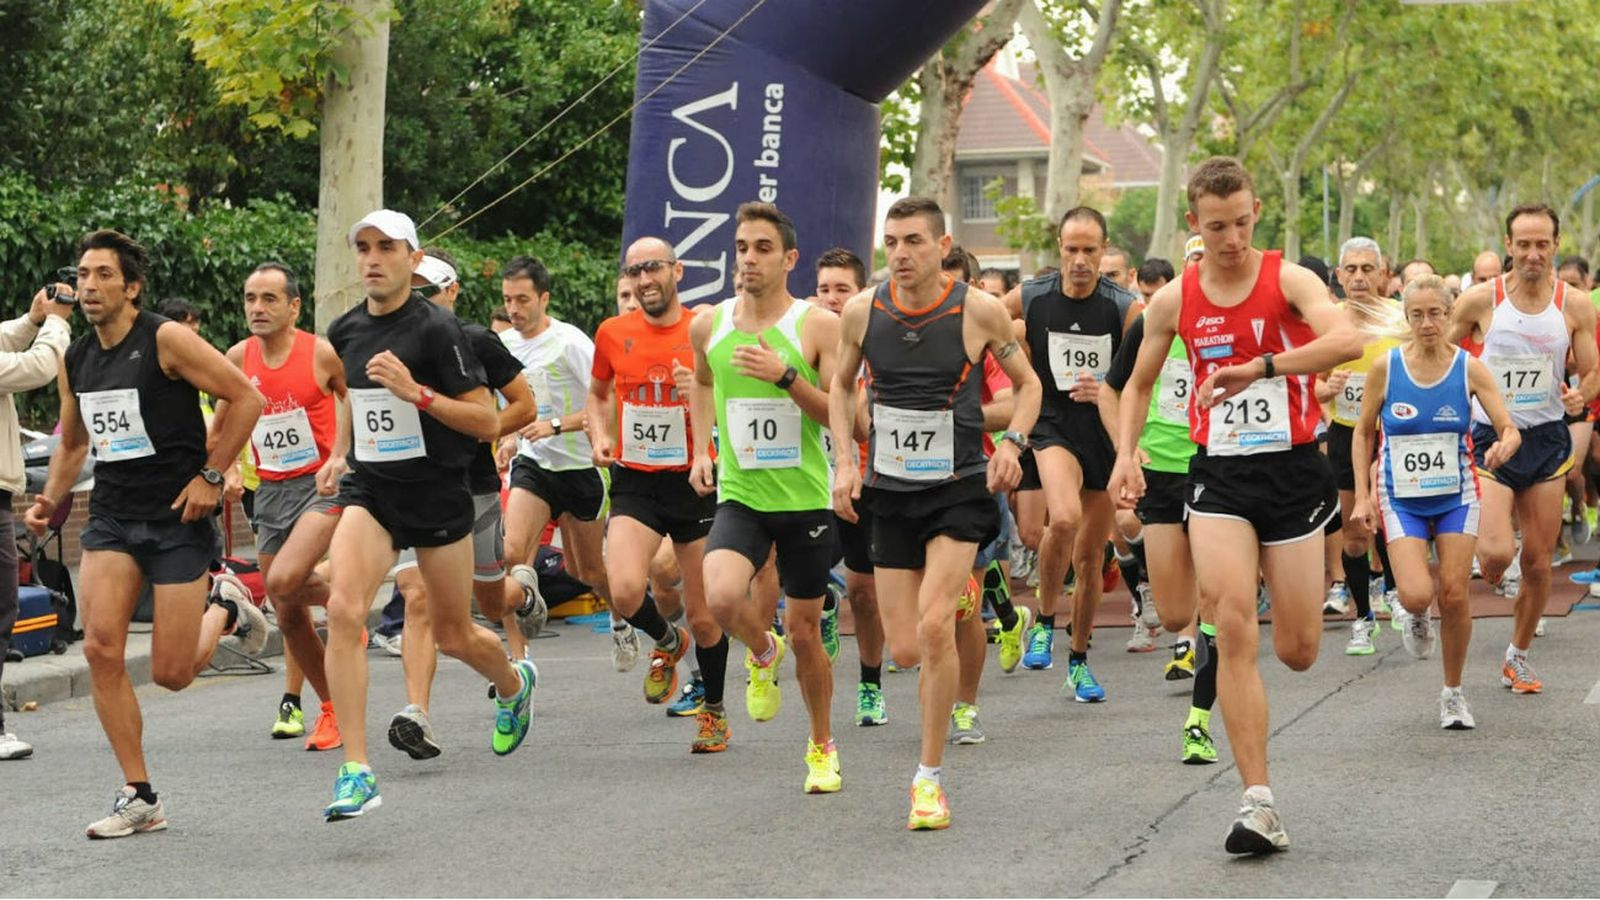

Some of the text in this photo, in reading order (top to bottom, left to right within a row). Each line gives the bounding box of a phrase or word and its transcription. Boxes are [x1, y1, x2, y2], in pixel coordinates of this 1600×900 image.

[754, 83, 784, 167] banca
[1194, 333, 1234, 347] MARATHON
[1063, 348, 1099, 368] 198
[1502, 370, 1541, 388] 177
[92, 409, 130, 434] 554
[366, 409, 394, 432] 65
[1222, 398, 1271, 424] 213
[263, 428, 300, 449] 426
[633, 423, 671, 442] 547
[748, 419, 777, 441] 10
[890, 429, 936, 451] 147
[1404, 451, 1446, 472] 694
